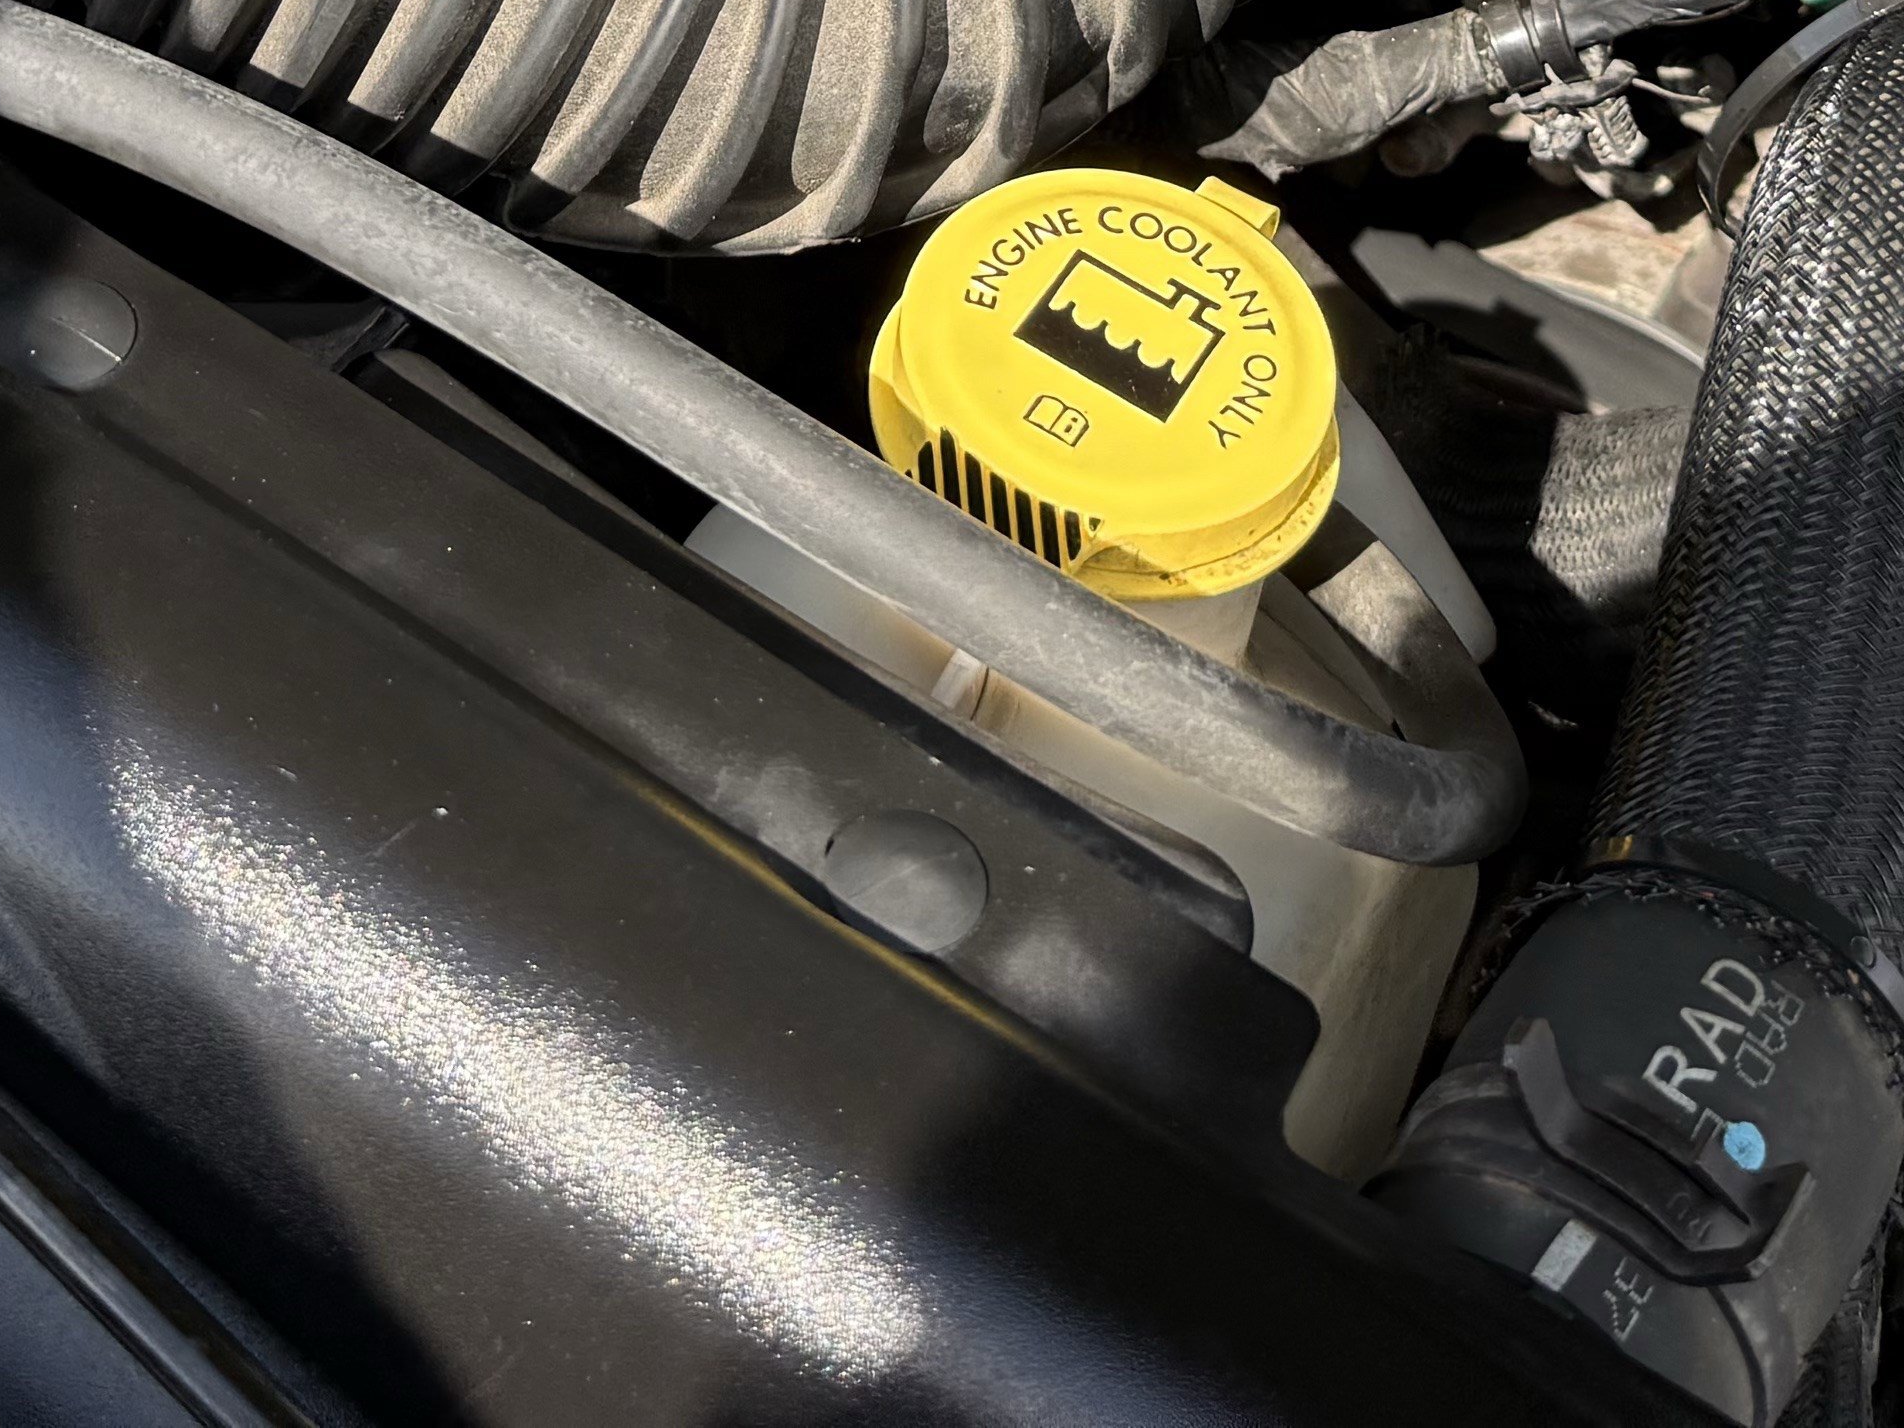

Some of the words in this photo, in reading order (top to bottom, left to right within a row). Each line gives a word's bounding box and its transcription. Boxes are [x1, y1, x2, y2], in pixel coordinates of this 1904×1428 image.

[964, 207, 1083, 310] ENGINE
[1097, 205, 1277, 336] COOLANT
[1208, 353, 1278, 449] ONLY
[1641, 958, 1766, 1113] RAD
